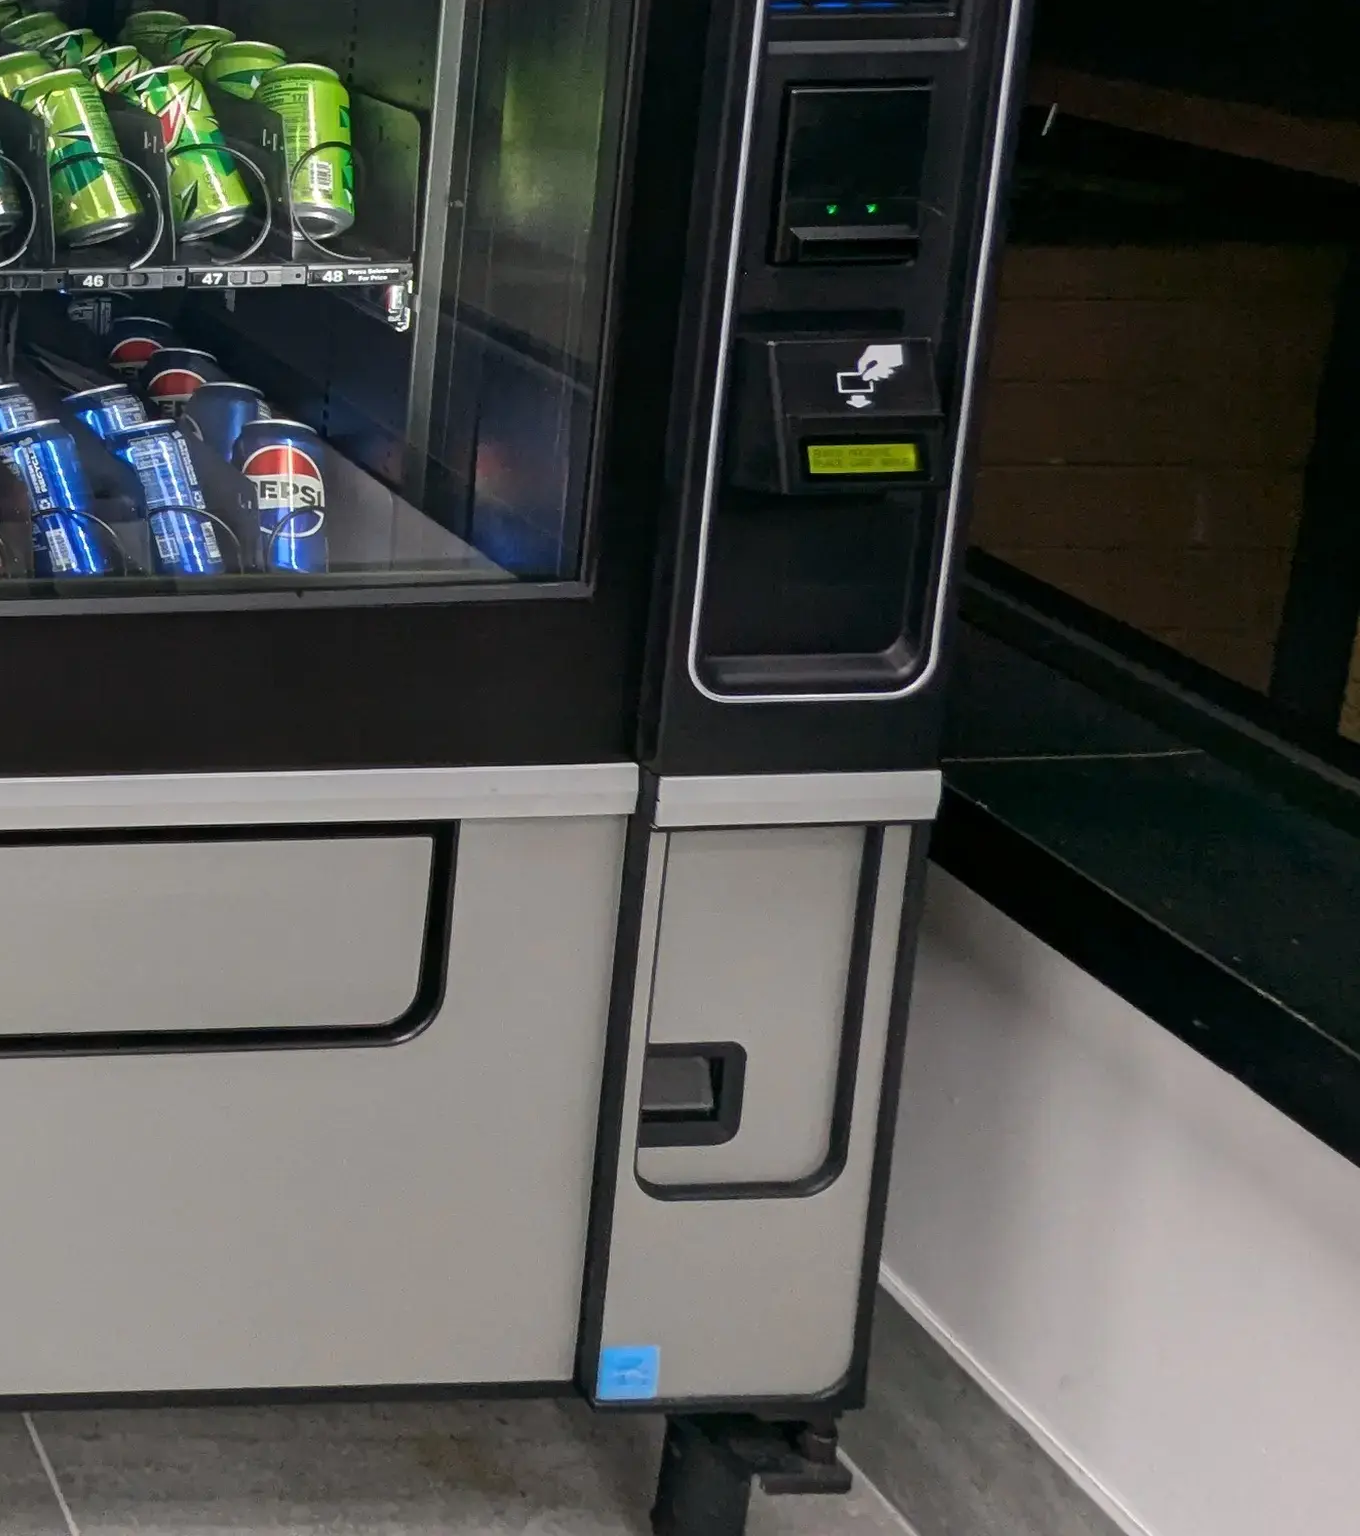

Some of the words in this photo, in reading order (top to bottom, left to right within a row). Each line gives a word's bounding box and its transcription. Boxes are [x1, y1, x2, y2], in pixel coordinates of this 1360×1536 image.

[83, 276, 104, 288] 46
[202, 273, 222, 285] 47
[323, 271, 343, 283] 48
[260, 481, 321, 506] EPSI
